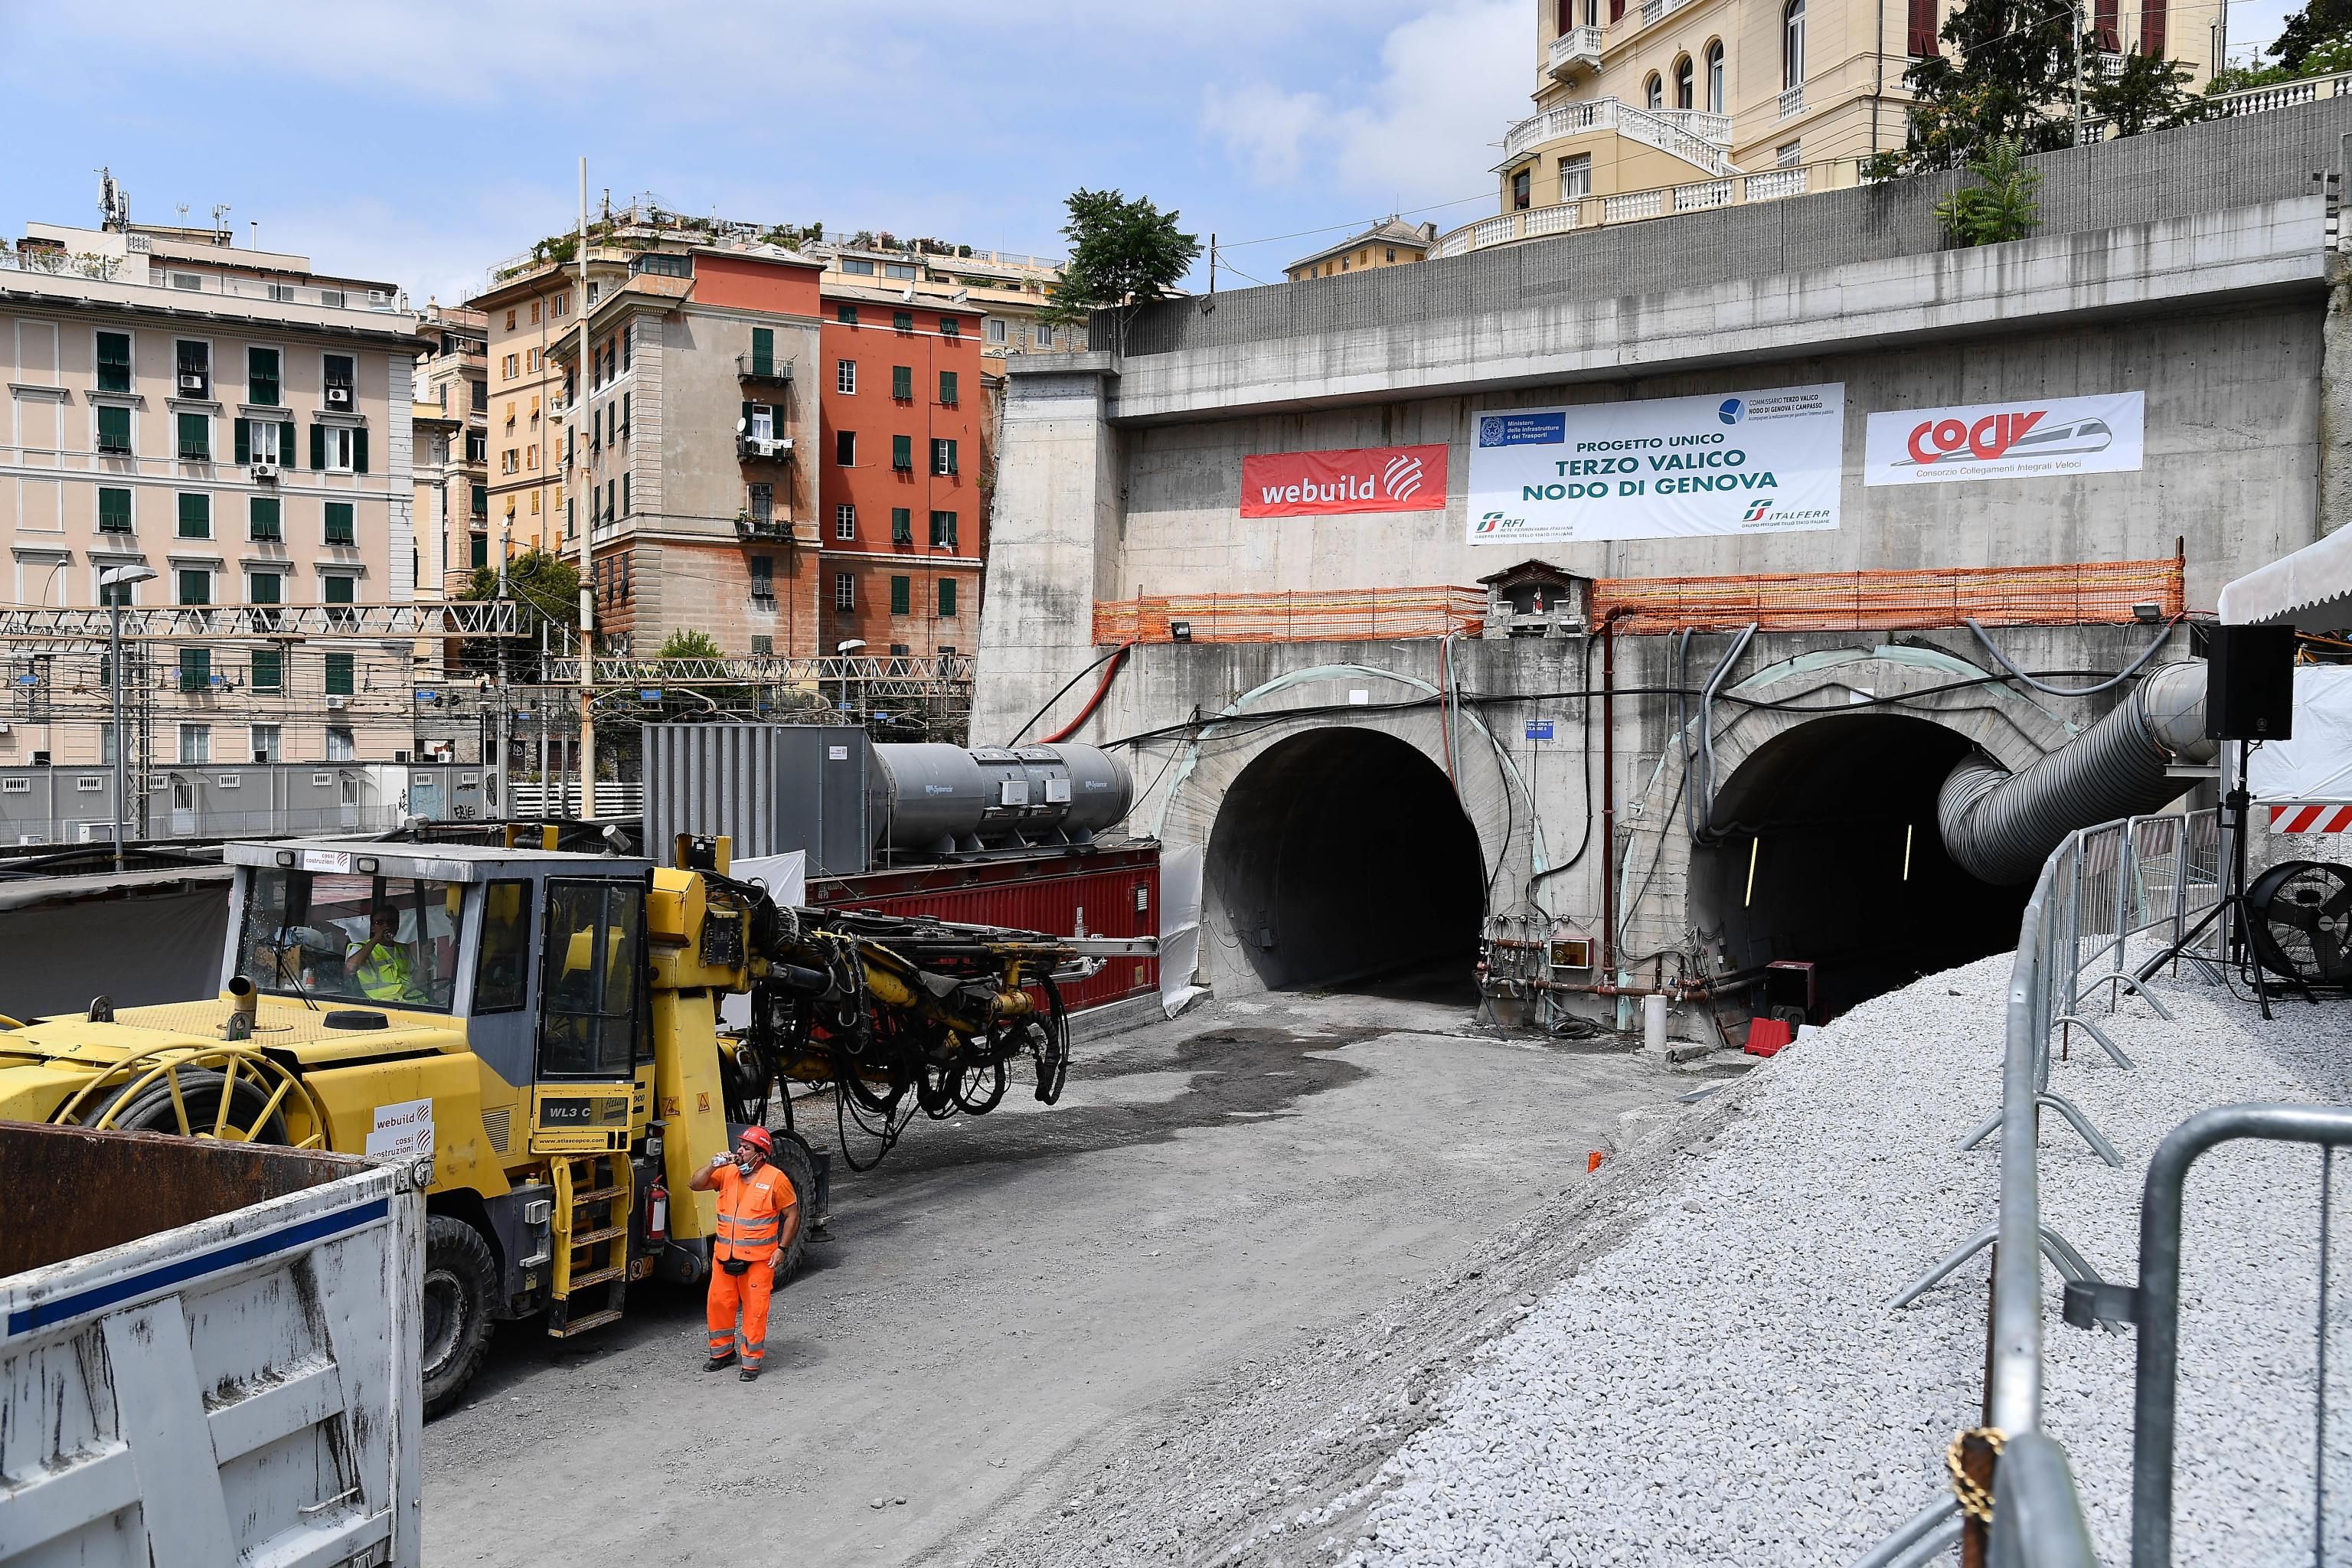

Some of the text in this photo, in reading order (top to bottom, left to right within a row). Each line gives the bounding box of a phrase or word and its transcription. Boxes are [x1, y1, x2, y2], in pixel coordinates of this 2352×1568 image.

[1749, 397, 1782, 407] COMMISSARIO
[1795, 402, 1823, 410] CAMPASSO
[1521, 432, 1547, 440] Trasporti
[1907, 410, 2049, 465] COCIV
[1576, 433, 1726, 452] PROGETTO UNICO
[1556, 449, 1746, 477] TERZO VALICO
[1916, 459, 2082, 478] Consorzio Collegamenti Integrati Veloci
[1263, 474, 1376, 505] webuild
[1523, 472, 1779, 501] NODO DI GENOVA
[1769, 510, 1830, 521] ITALFERR
[1501, 518, 1525, 528] RFI
[633, 1094, 645, 1104] pco
[550, 1107, 592, 1117] WL3 C
[377, 1112, 415, 1129] webuild
[395, 1134, 413, 1145] cossi
